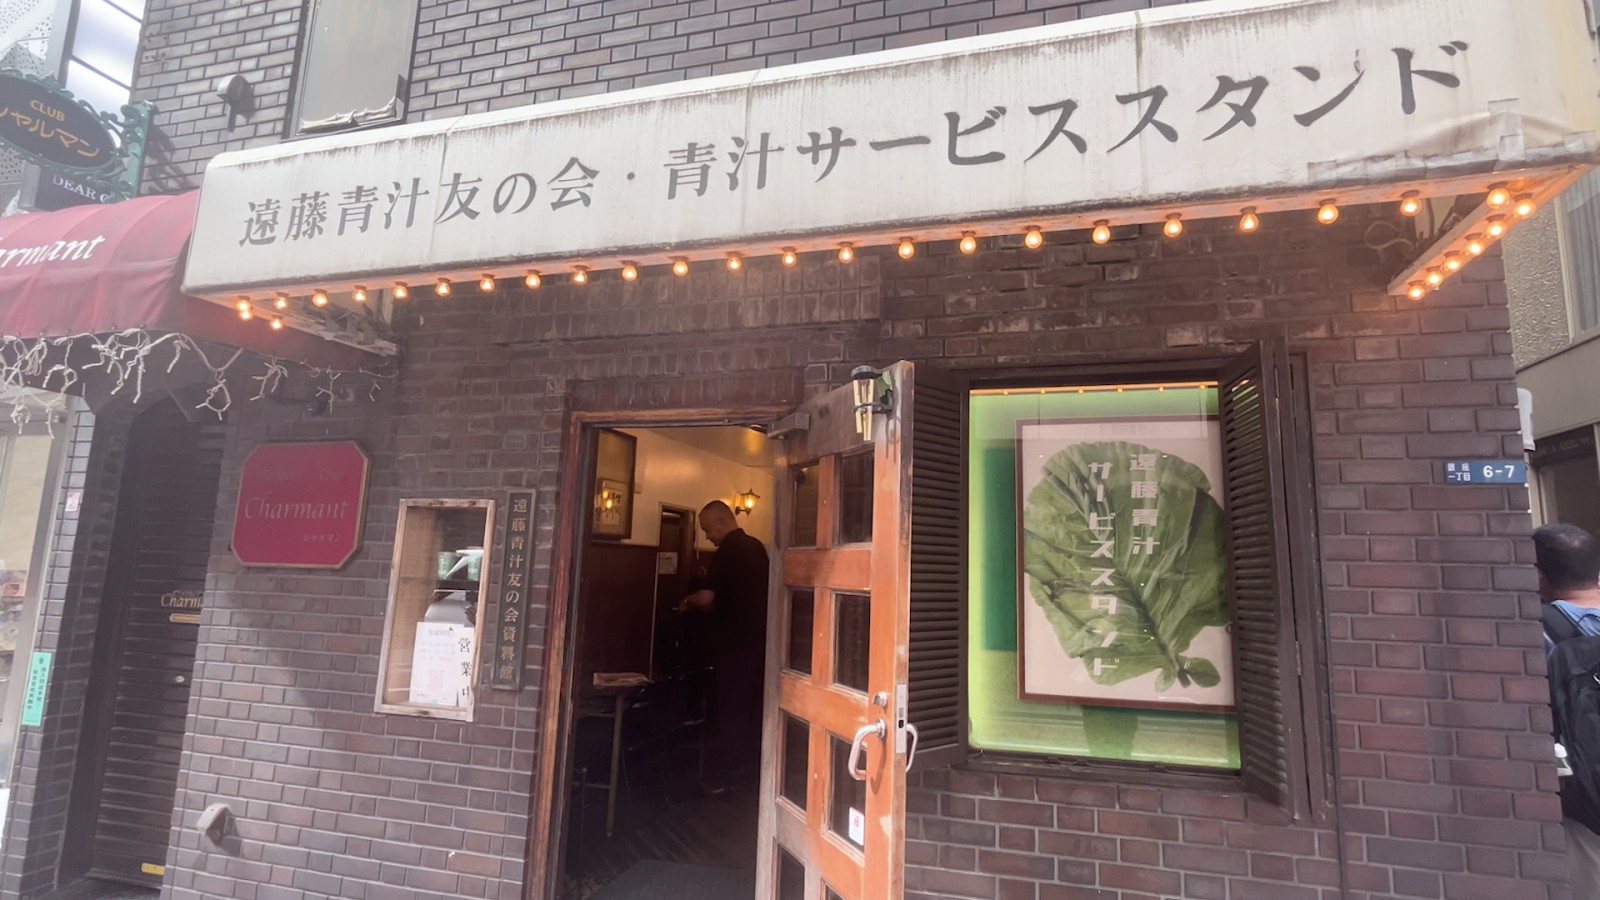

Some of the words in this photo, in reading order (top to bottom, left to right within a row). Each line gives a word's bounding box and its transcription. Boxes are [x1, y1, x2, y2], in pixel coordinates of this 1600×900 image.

[30, 99, 65, 122] CLUB
[52, 173, 97, 200] DEAR
[1447, 462, 1470, 472] 銀座
[1448, 472, 1471, 481] 一丁目
[1482, 464, 1515, 479] 6-7
[244, 490, 350, 520] Charmant
[1129, 453, 1161, 556] 遠藤青汁
[1087, 461, 1120, 678] サービススタンド
[498, 498, 528, 680] 遠藤青汁友の会資料館
